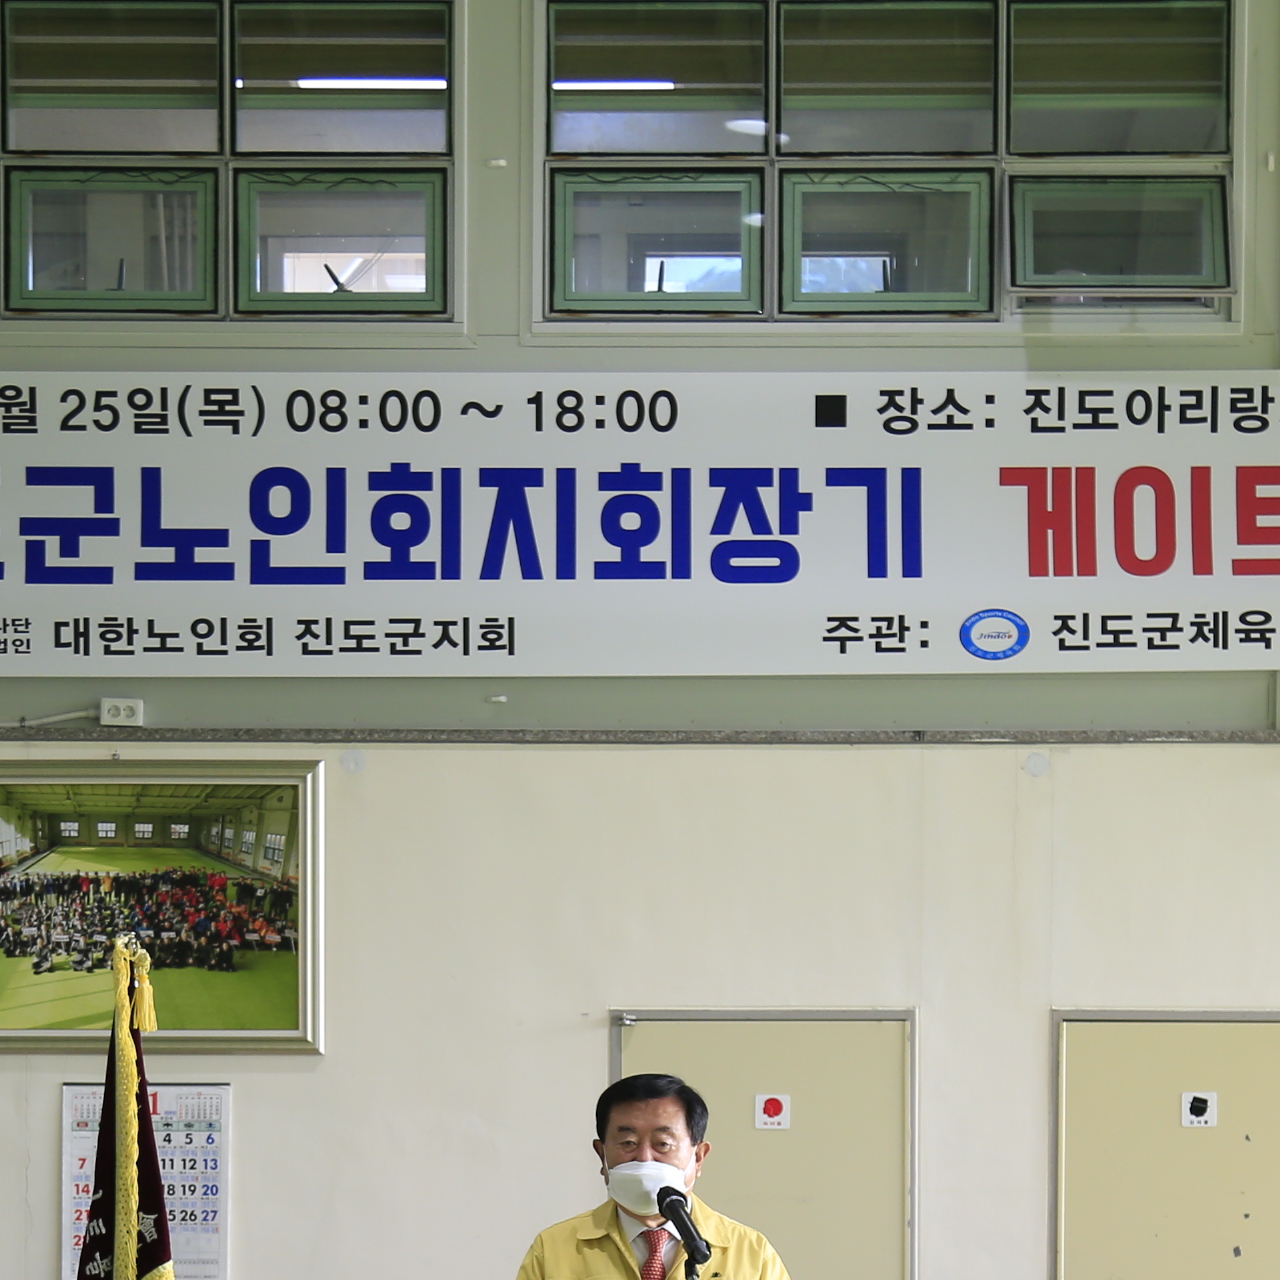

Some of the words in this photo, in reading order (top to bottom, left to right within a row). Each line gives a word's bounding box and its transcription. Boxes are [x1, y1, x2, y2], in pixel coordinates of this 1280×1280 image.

[58, 384, 267, 437] 25일(목)
[285, 389, 442, 433] 08:00
[527, 389, 678, 433] 18:00
[876, 387, 995, 435] 장소:
[53, 616, 274, 656] 대한노인회
[295, 616, 516, 656] 진도군지회
[822, 614, 929, 654] 주관:
[163, 1132, 172, 1145] 4
[184, 1132, 193, 1145] 5
[206, 1132, 215, 1145] 6
[78, 1158, 86, 1170] 7
[160, 1158, 174, 1170] 11
[181, 1158, 197, 1170] 12
[202, 1158, 218, 1170] 13
[74, 1184, 91, 1195] 14
[181, 1184, 196, 1196] 19
[201, 1184, 219, 1196] 20
[180, 1209, 197, 1222] 26
[201, 1209, 218, 1222] 27
